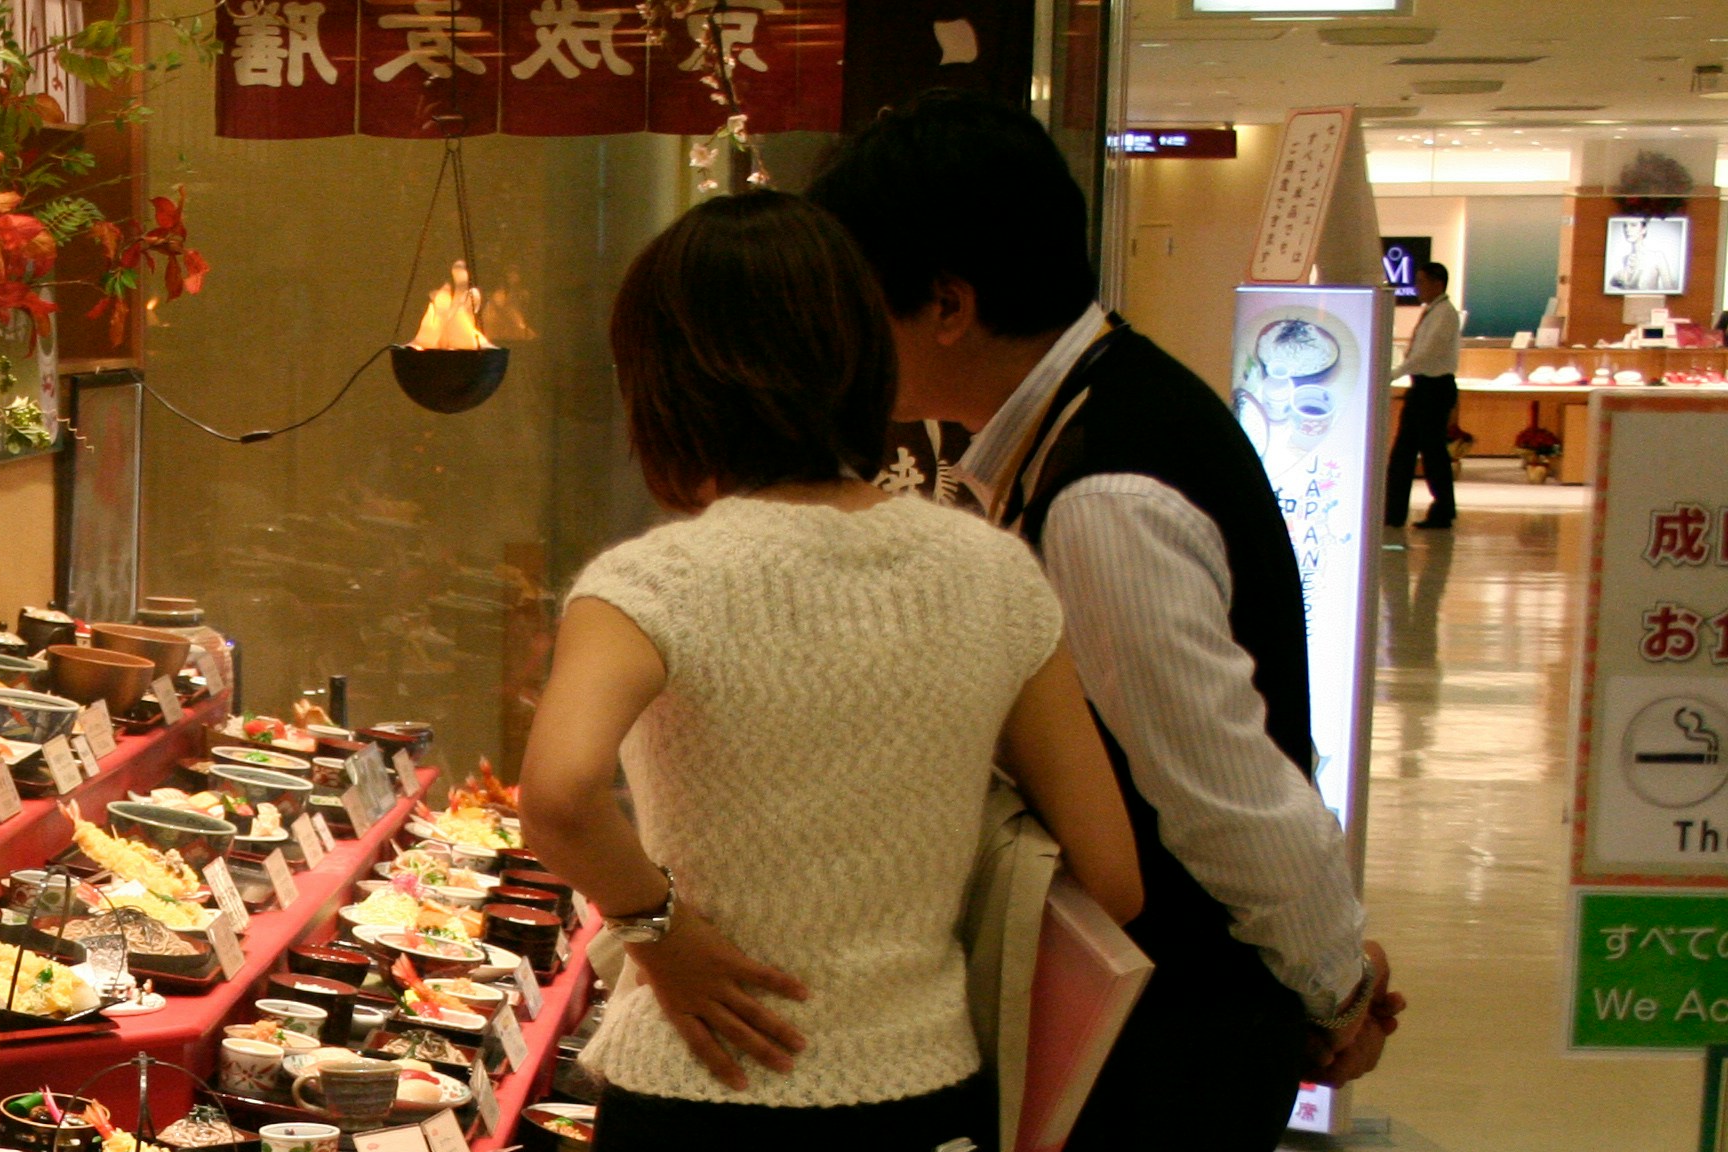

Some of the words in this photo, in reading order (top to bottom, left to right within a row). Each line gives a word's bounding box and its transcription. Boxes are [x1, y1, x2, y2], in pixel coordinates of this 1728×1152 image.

[1646, 505, 1728, 563] 成
[1643, 606, 1728, 658] お
[1673, 819, 1728, 852] Th
[1593, 987, 1660, 1022] We
